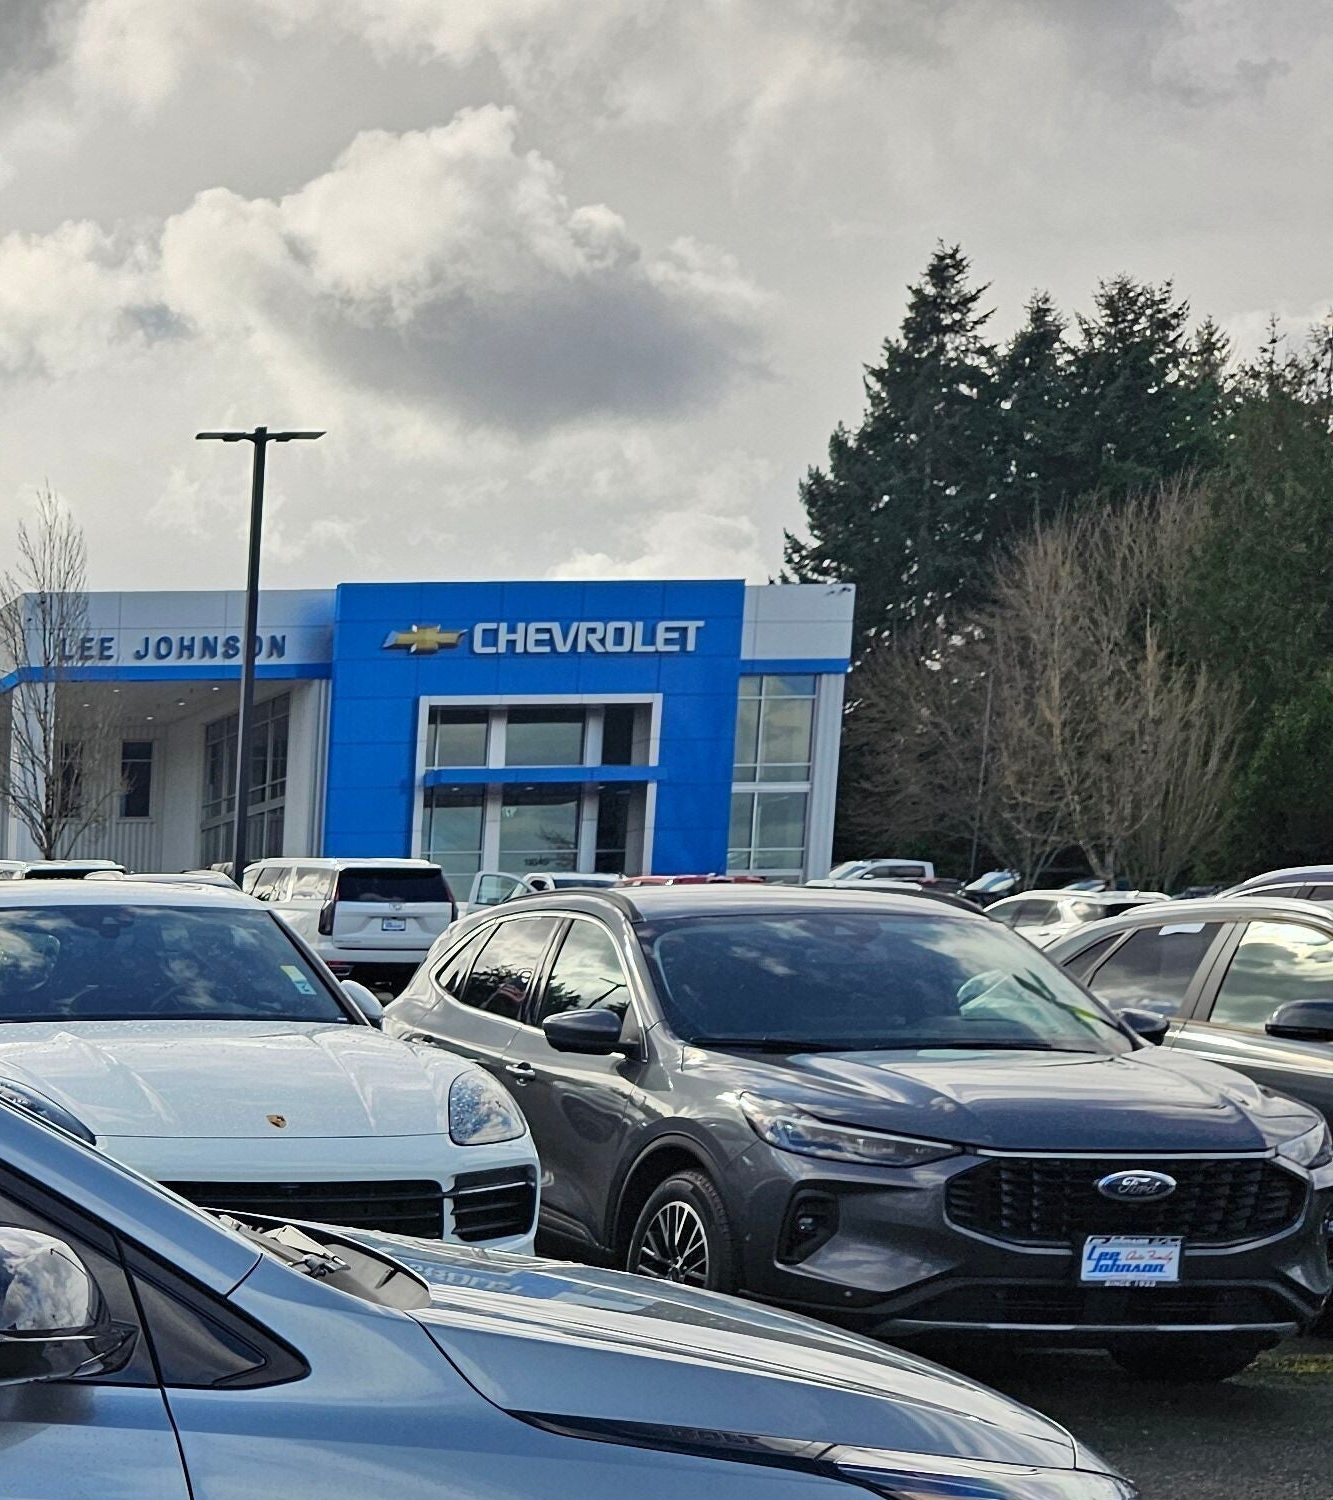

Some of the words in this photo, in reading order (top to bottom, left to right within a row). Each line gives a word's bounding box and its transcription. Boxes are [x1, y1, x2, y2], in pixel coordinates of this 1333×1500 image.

[473, 619, 706, 654] CHEVROLET
[60, 636, 115, 661] LEE
[1117, 1176, 1161, 1195] Ford
[1087, 1245, 1122, 1261] Lee
[1087, 1260, 1167, 1273] Johnson
